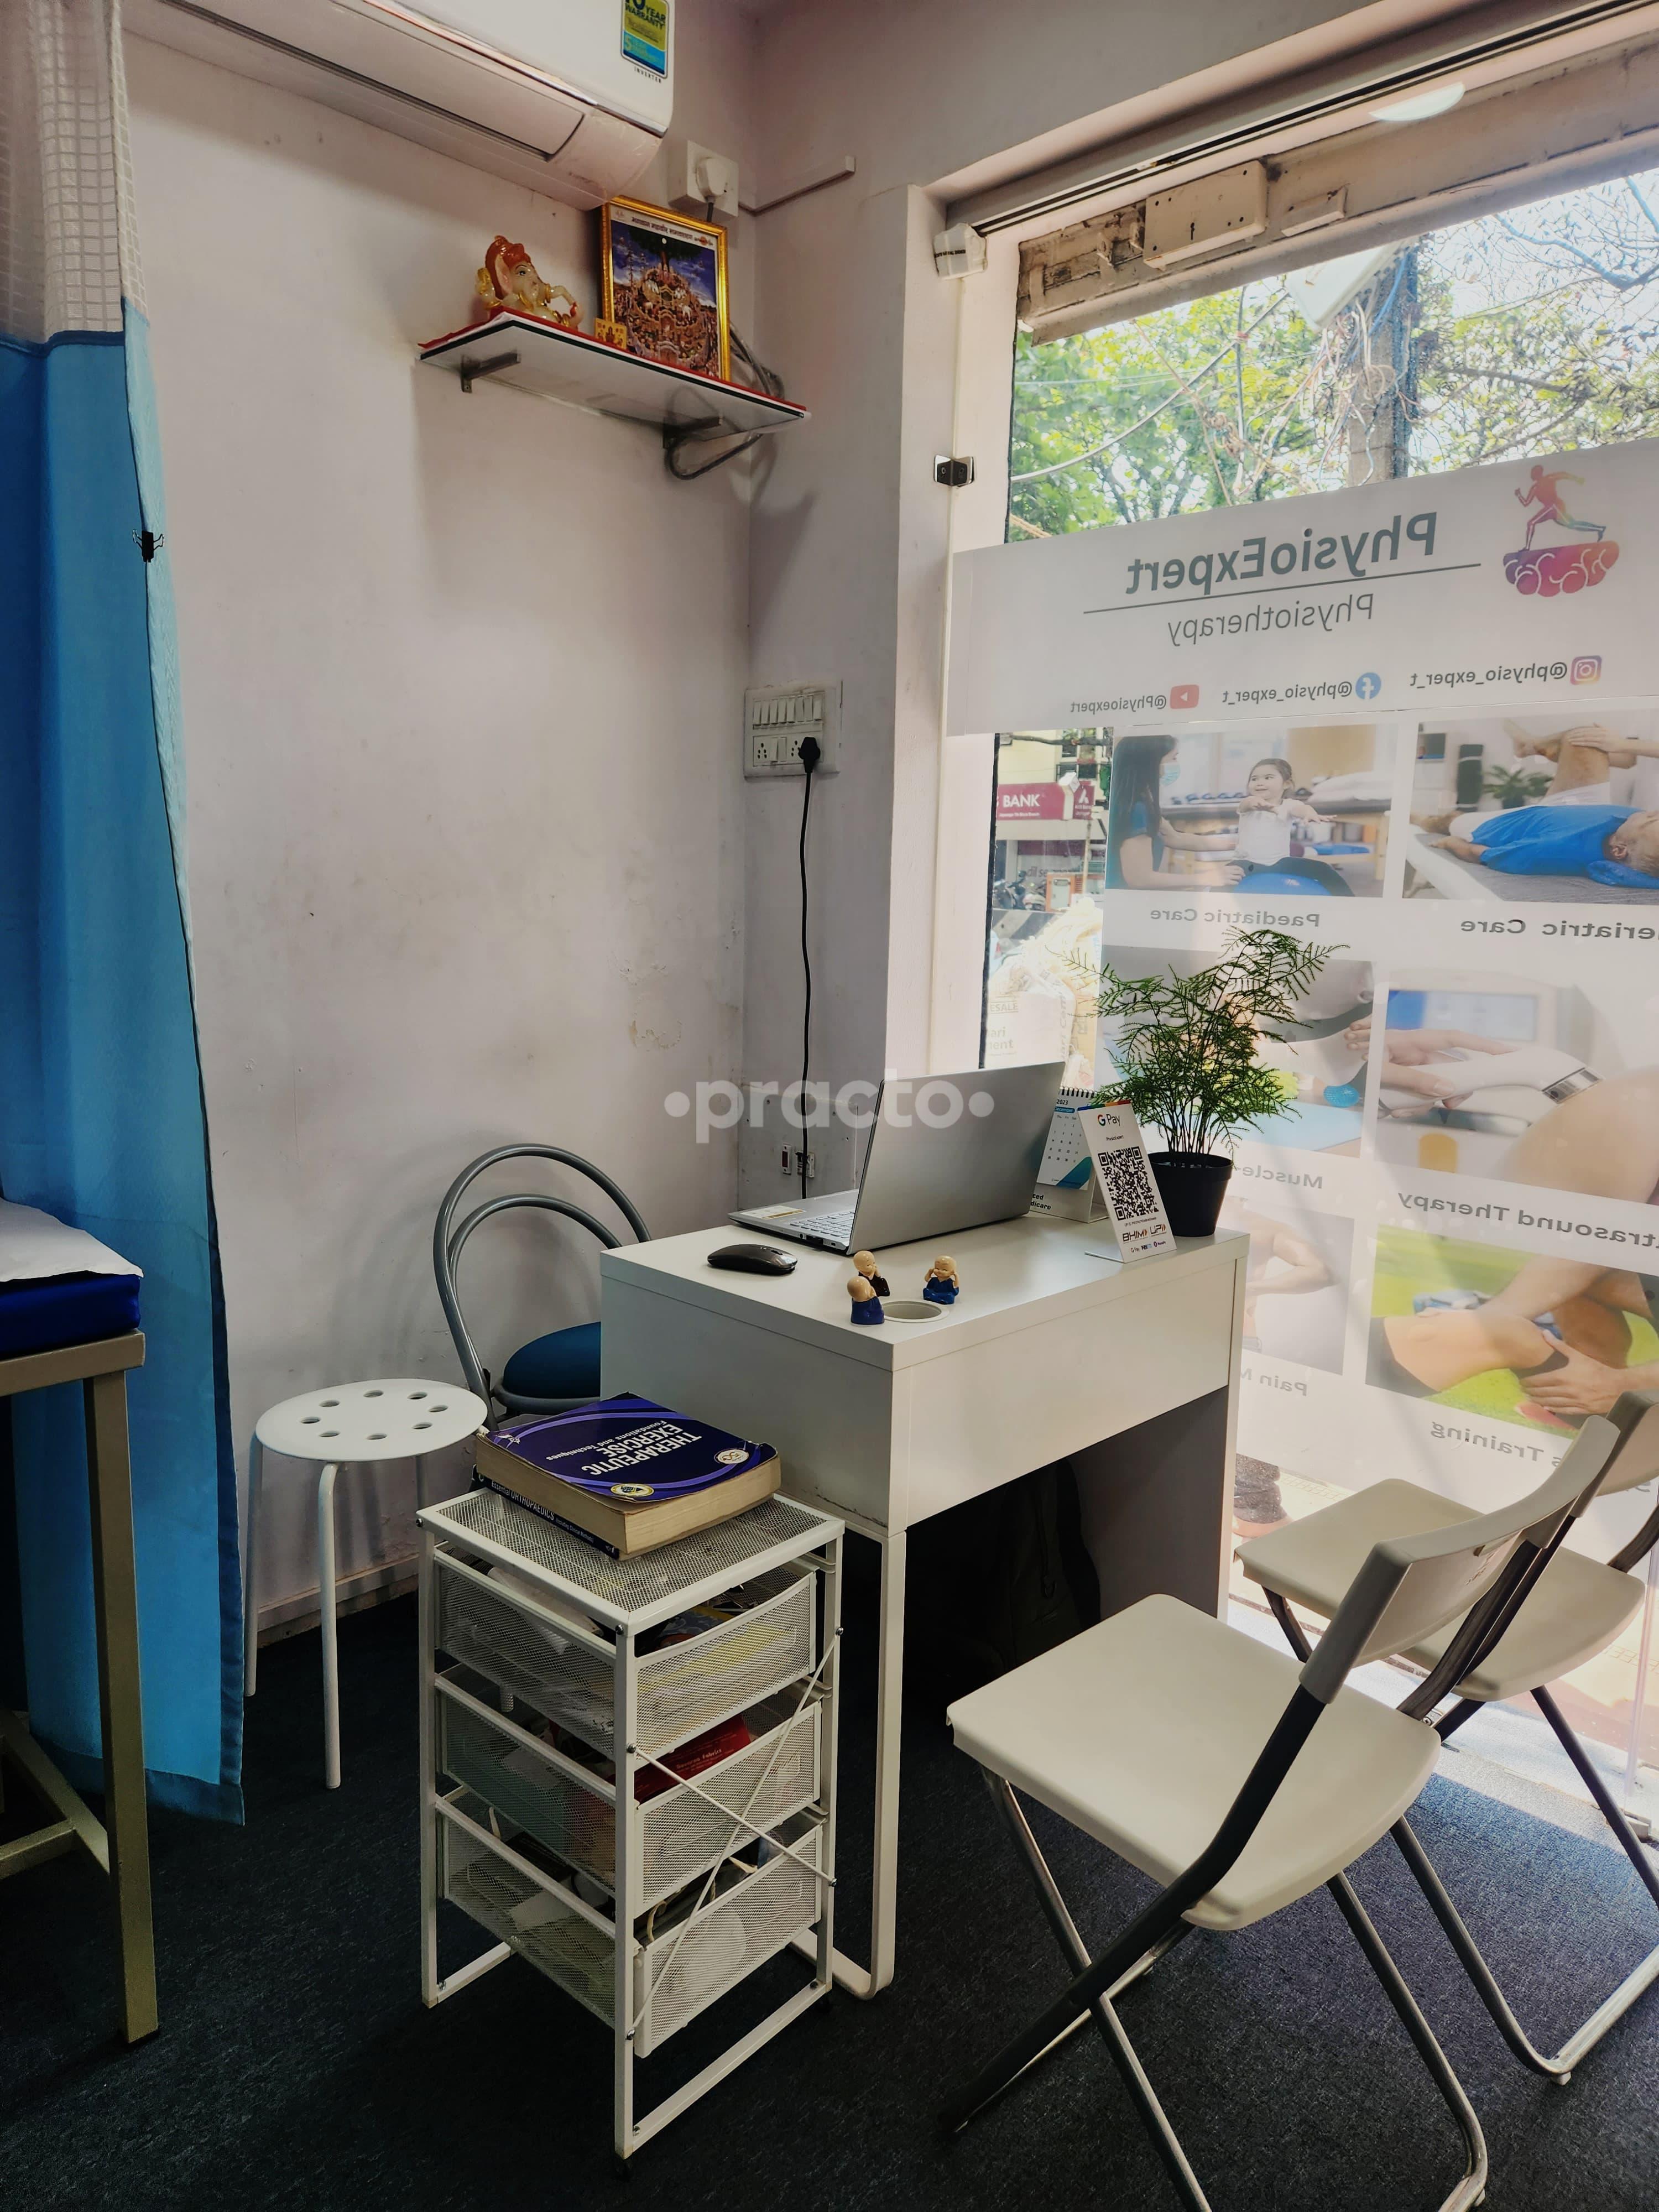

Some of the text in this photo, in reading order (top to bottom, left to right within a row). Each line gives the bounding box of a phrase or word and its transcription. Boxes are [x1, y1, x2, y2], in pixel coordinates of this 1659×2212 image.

[625, 3, 665, 30] WARRANTY
[646, 5, 666, 22] YEAR
[634, 66, 661, 84] INVERTER
[1003, 794, 1040, 807] BANK
[990, 1003, 1018, 1012] ESALE
[1097, 1113, 1121, 1126] G Pay
[1030, 1201, 1051, 1210] dicare
[1123, 1223, 1164, 1242] BHIM UPI
[545, 1420, 667, 1460] Foundations and Techniques
[595, 1423, 684, 1458] EXERCISE
[581, 1432, 702, 1475] THERAPEUTIC
[491, 1479, 511, 1496] Essential
[510, 1491, 555, 1521] ORTHOPAEDICS
